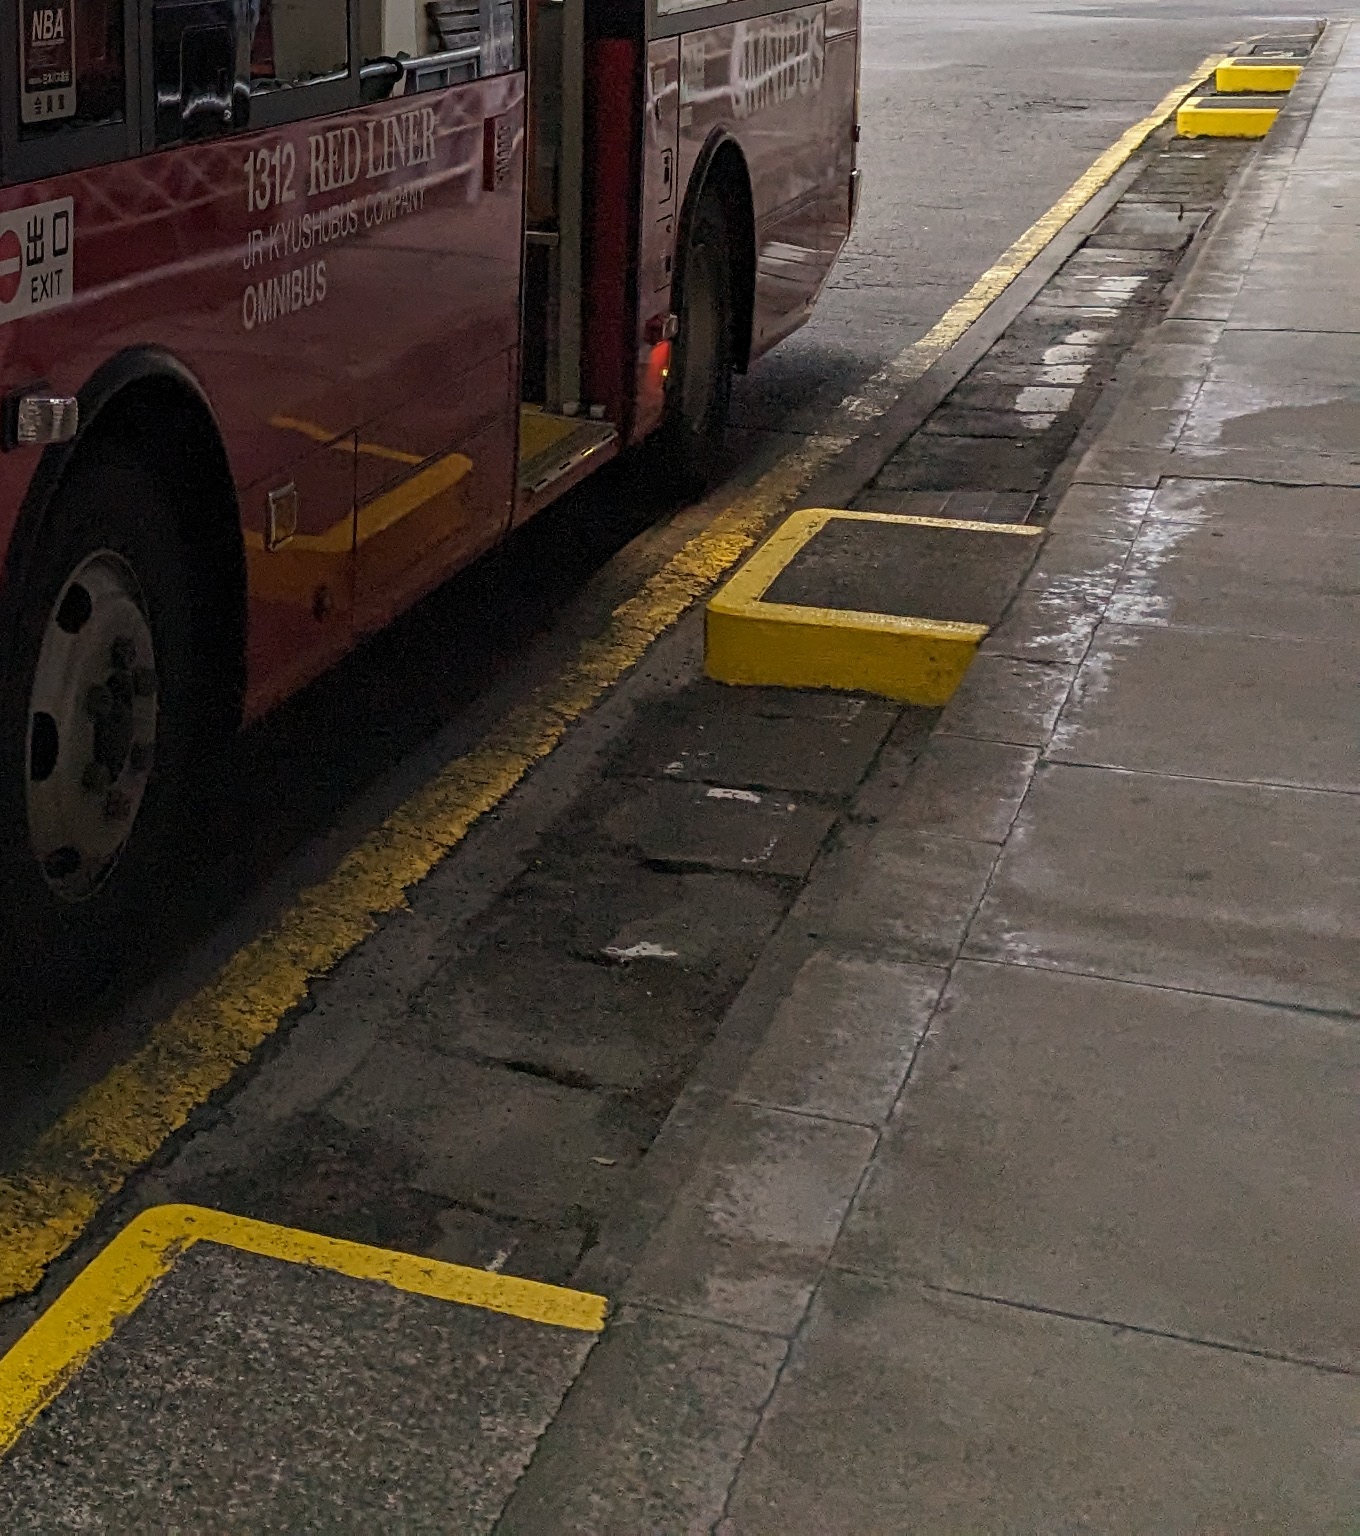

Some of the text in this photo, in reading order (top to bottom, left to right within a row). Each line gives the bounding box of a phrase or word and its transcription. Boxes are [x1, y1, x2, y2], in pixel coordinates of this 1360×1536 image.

[32, 7, 65, 40] NBA
[243, 142, 296, 212] 1312
[306, 127, 362, 196] RED
[365, 107, 437, 179] LINER
[26, 209, 69, 266] 出口
[243, 185, 428, 270] JR KYUSHUBUS COMPANY
[30, 268, 63, 304] EXIT
[242, 260, 328, 330] OMNIBUS
